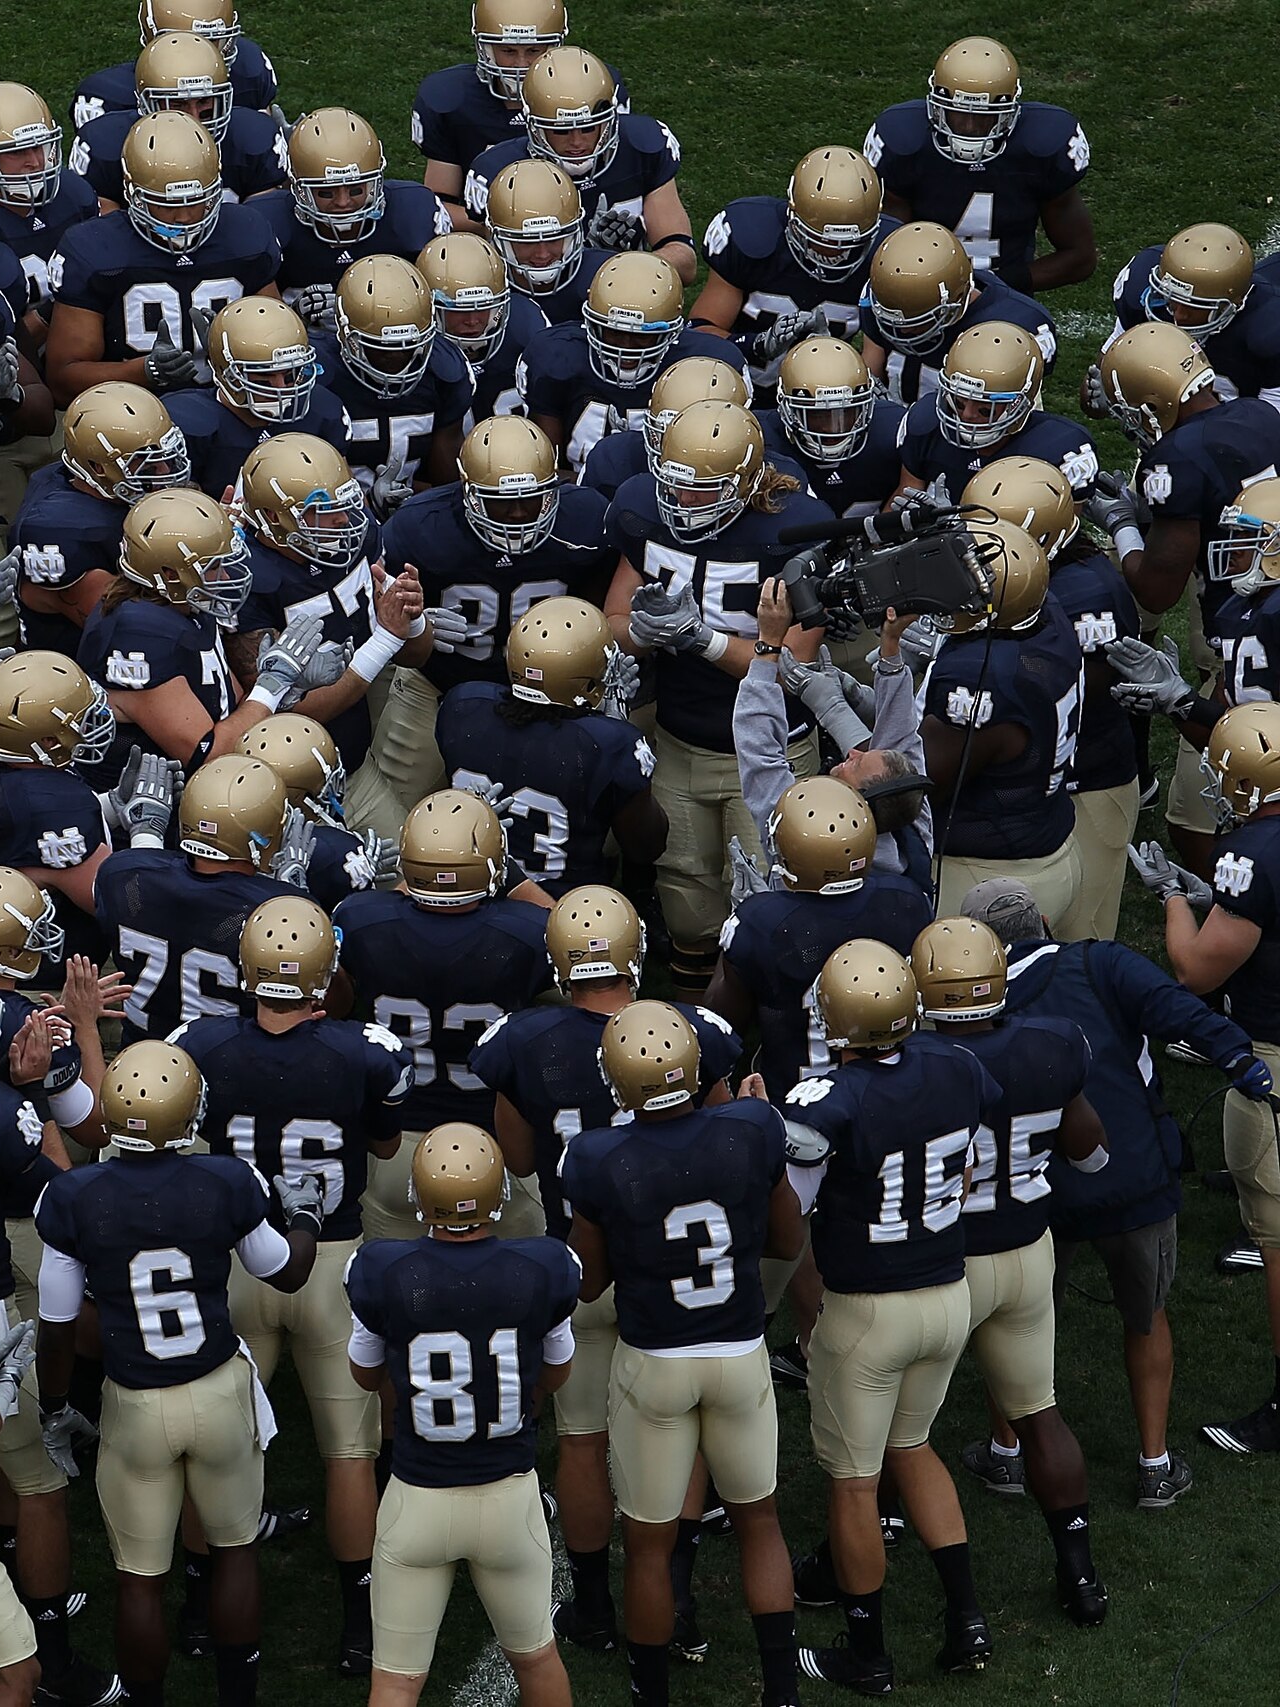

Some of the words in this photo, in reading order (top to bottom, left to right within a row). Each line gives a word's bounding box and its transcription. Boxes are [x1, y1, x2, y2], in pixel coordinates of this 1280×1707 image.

[953, 191, 1001, 270] 4
[181, 841, 218, 856] IRISH
[451, 768, 570, 882] 3
[118, 924, 241, 1026] 76
[576, 965, 609, 973] IRISH
[868, 1126, 971, 1243] 15
[128, 1246, 207, 1360] 6
[663, 1199, 736, 1311] 3
[408, 1327, 525, 1443] 81
